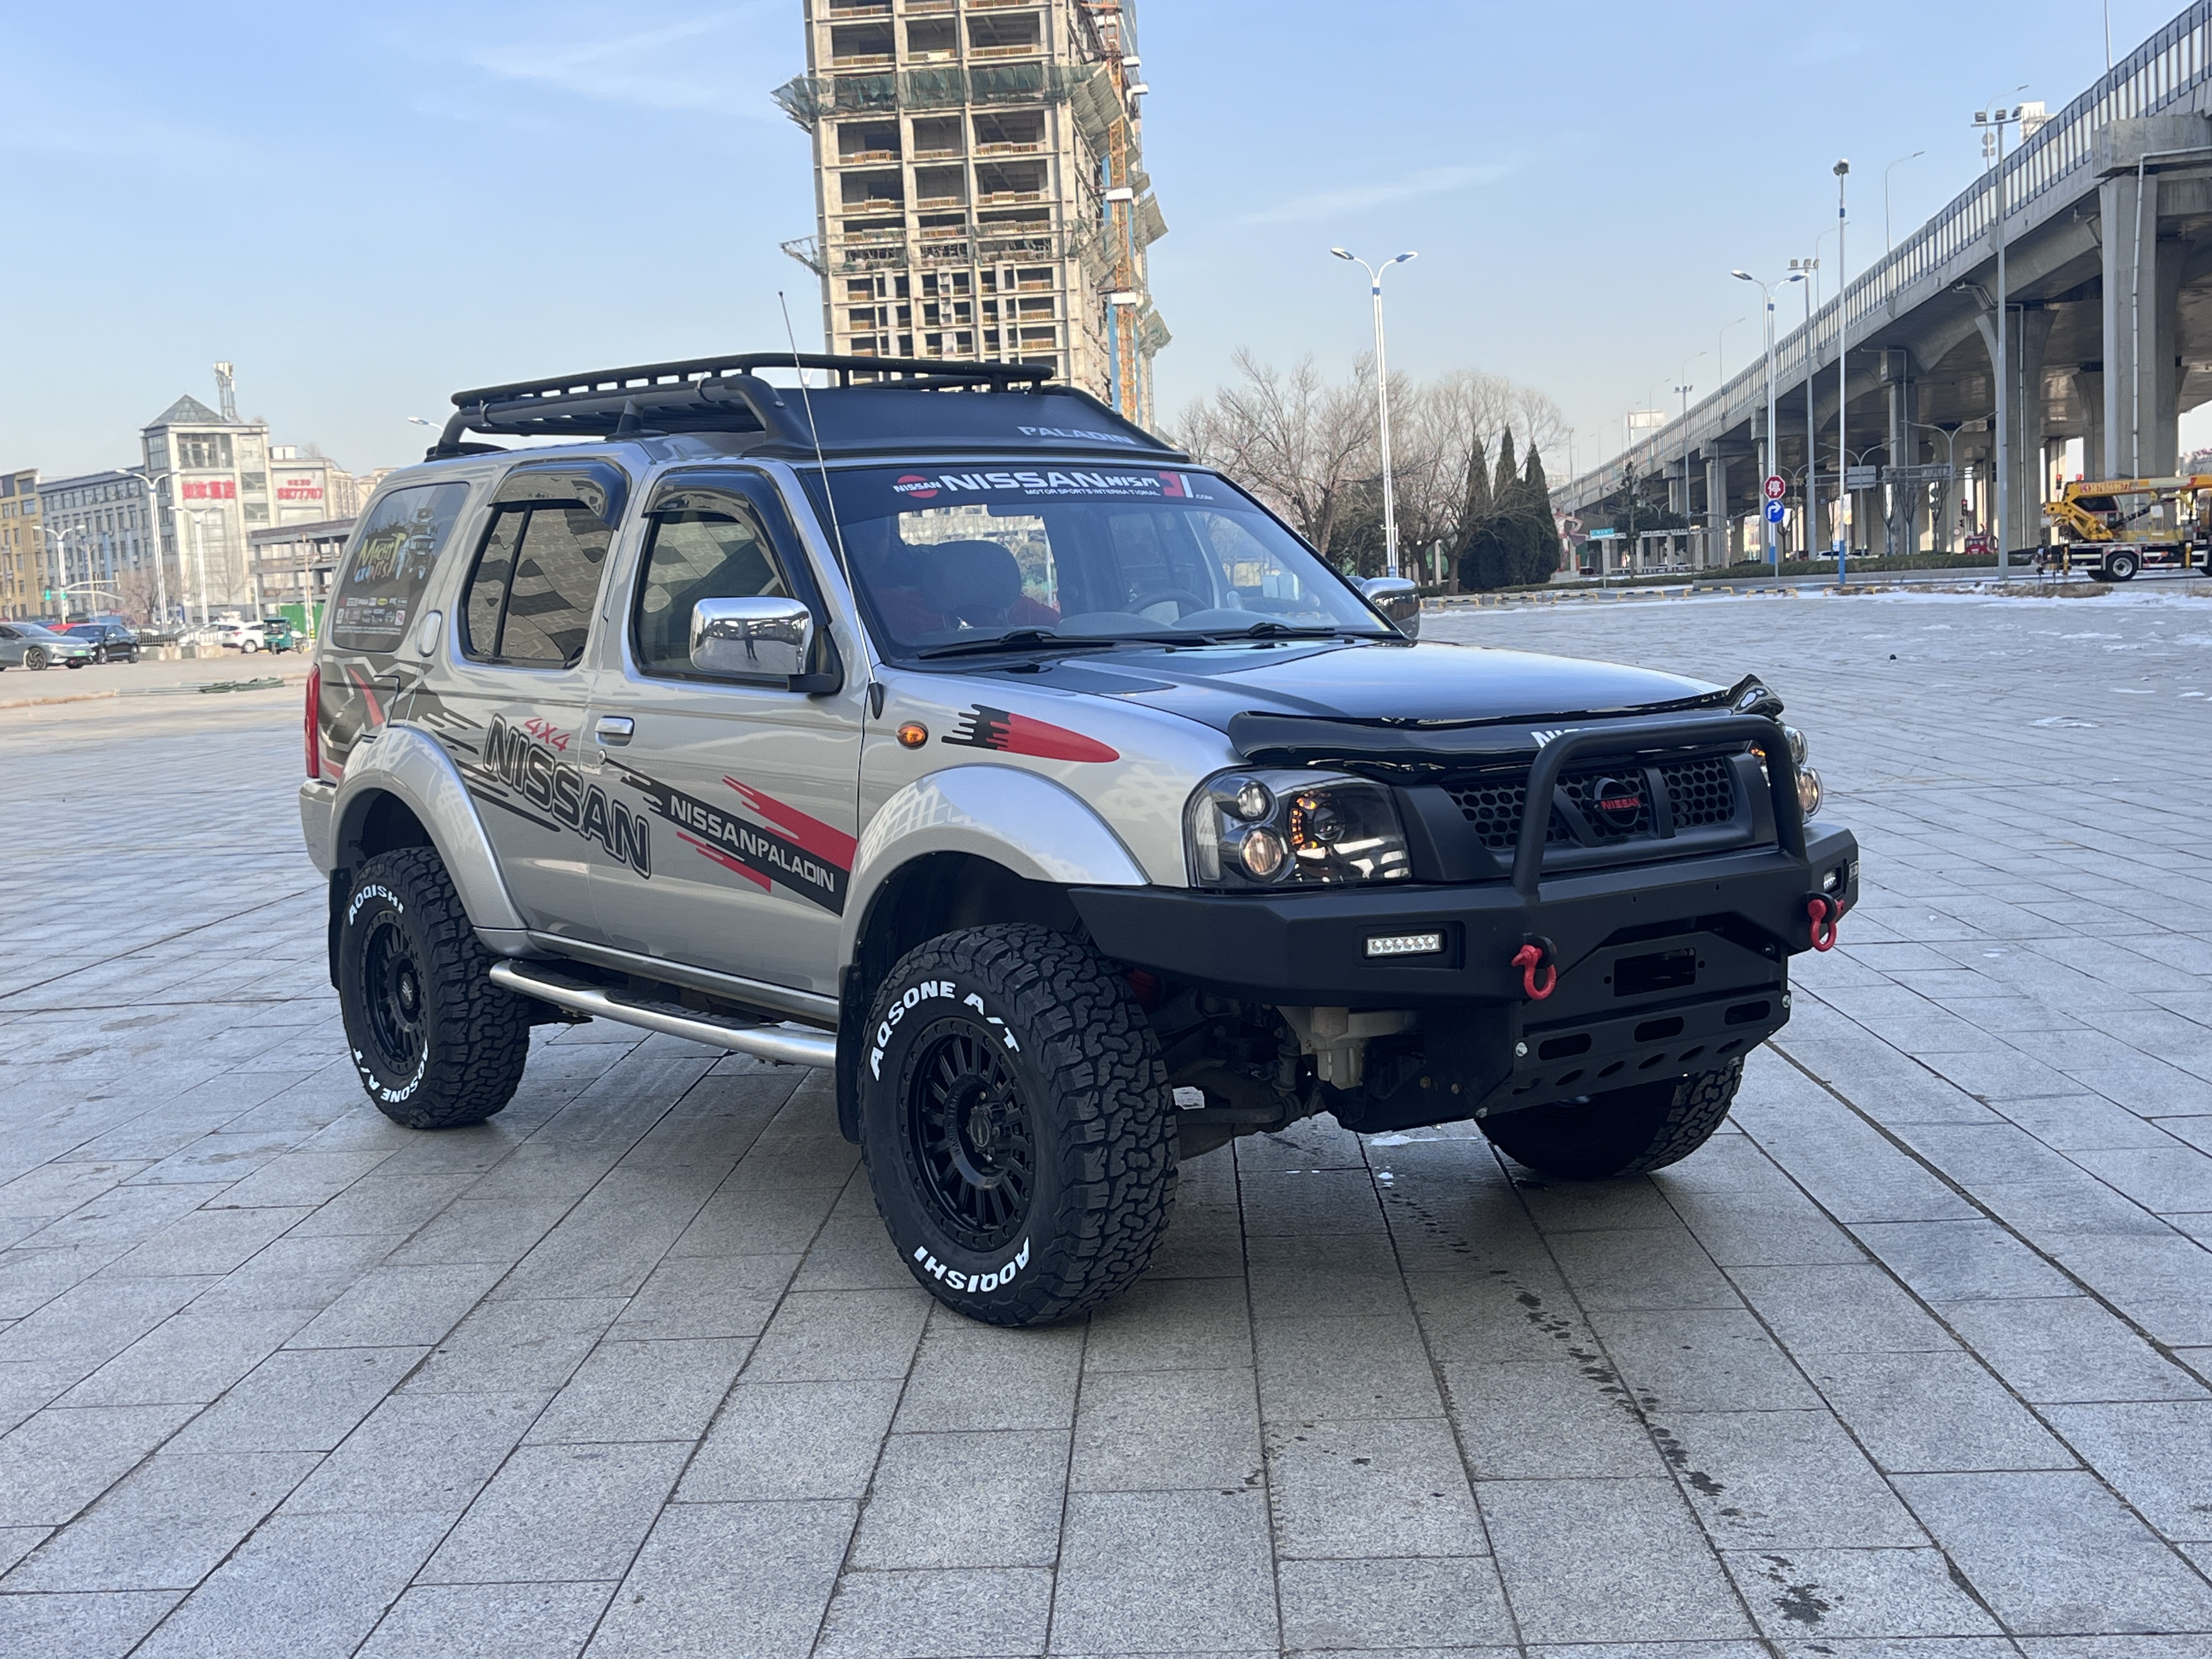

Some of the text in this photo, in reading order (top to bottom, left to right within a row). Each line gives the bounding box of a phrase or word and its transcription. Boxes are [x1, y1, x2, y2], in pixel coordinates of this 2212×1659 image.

[1017, 426, 1136, 445] PALADIN
[893, 481, 943, 493] NISSAN
[938, 472, 1110, 492] NISSAN
[524, 717, 571, 752] 4X4
[483, 713, 651, 879] NISSAN
[1600, 796, 1641, 810] NISSAN
[349, 883, 404, 926] AOQISHI
[870, 980, 1020, 1081] AQSONE A/T
[380, 1037, 428, 1103] AQSONE
[913, 1236, 1030, 1293] AOQISHI
